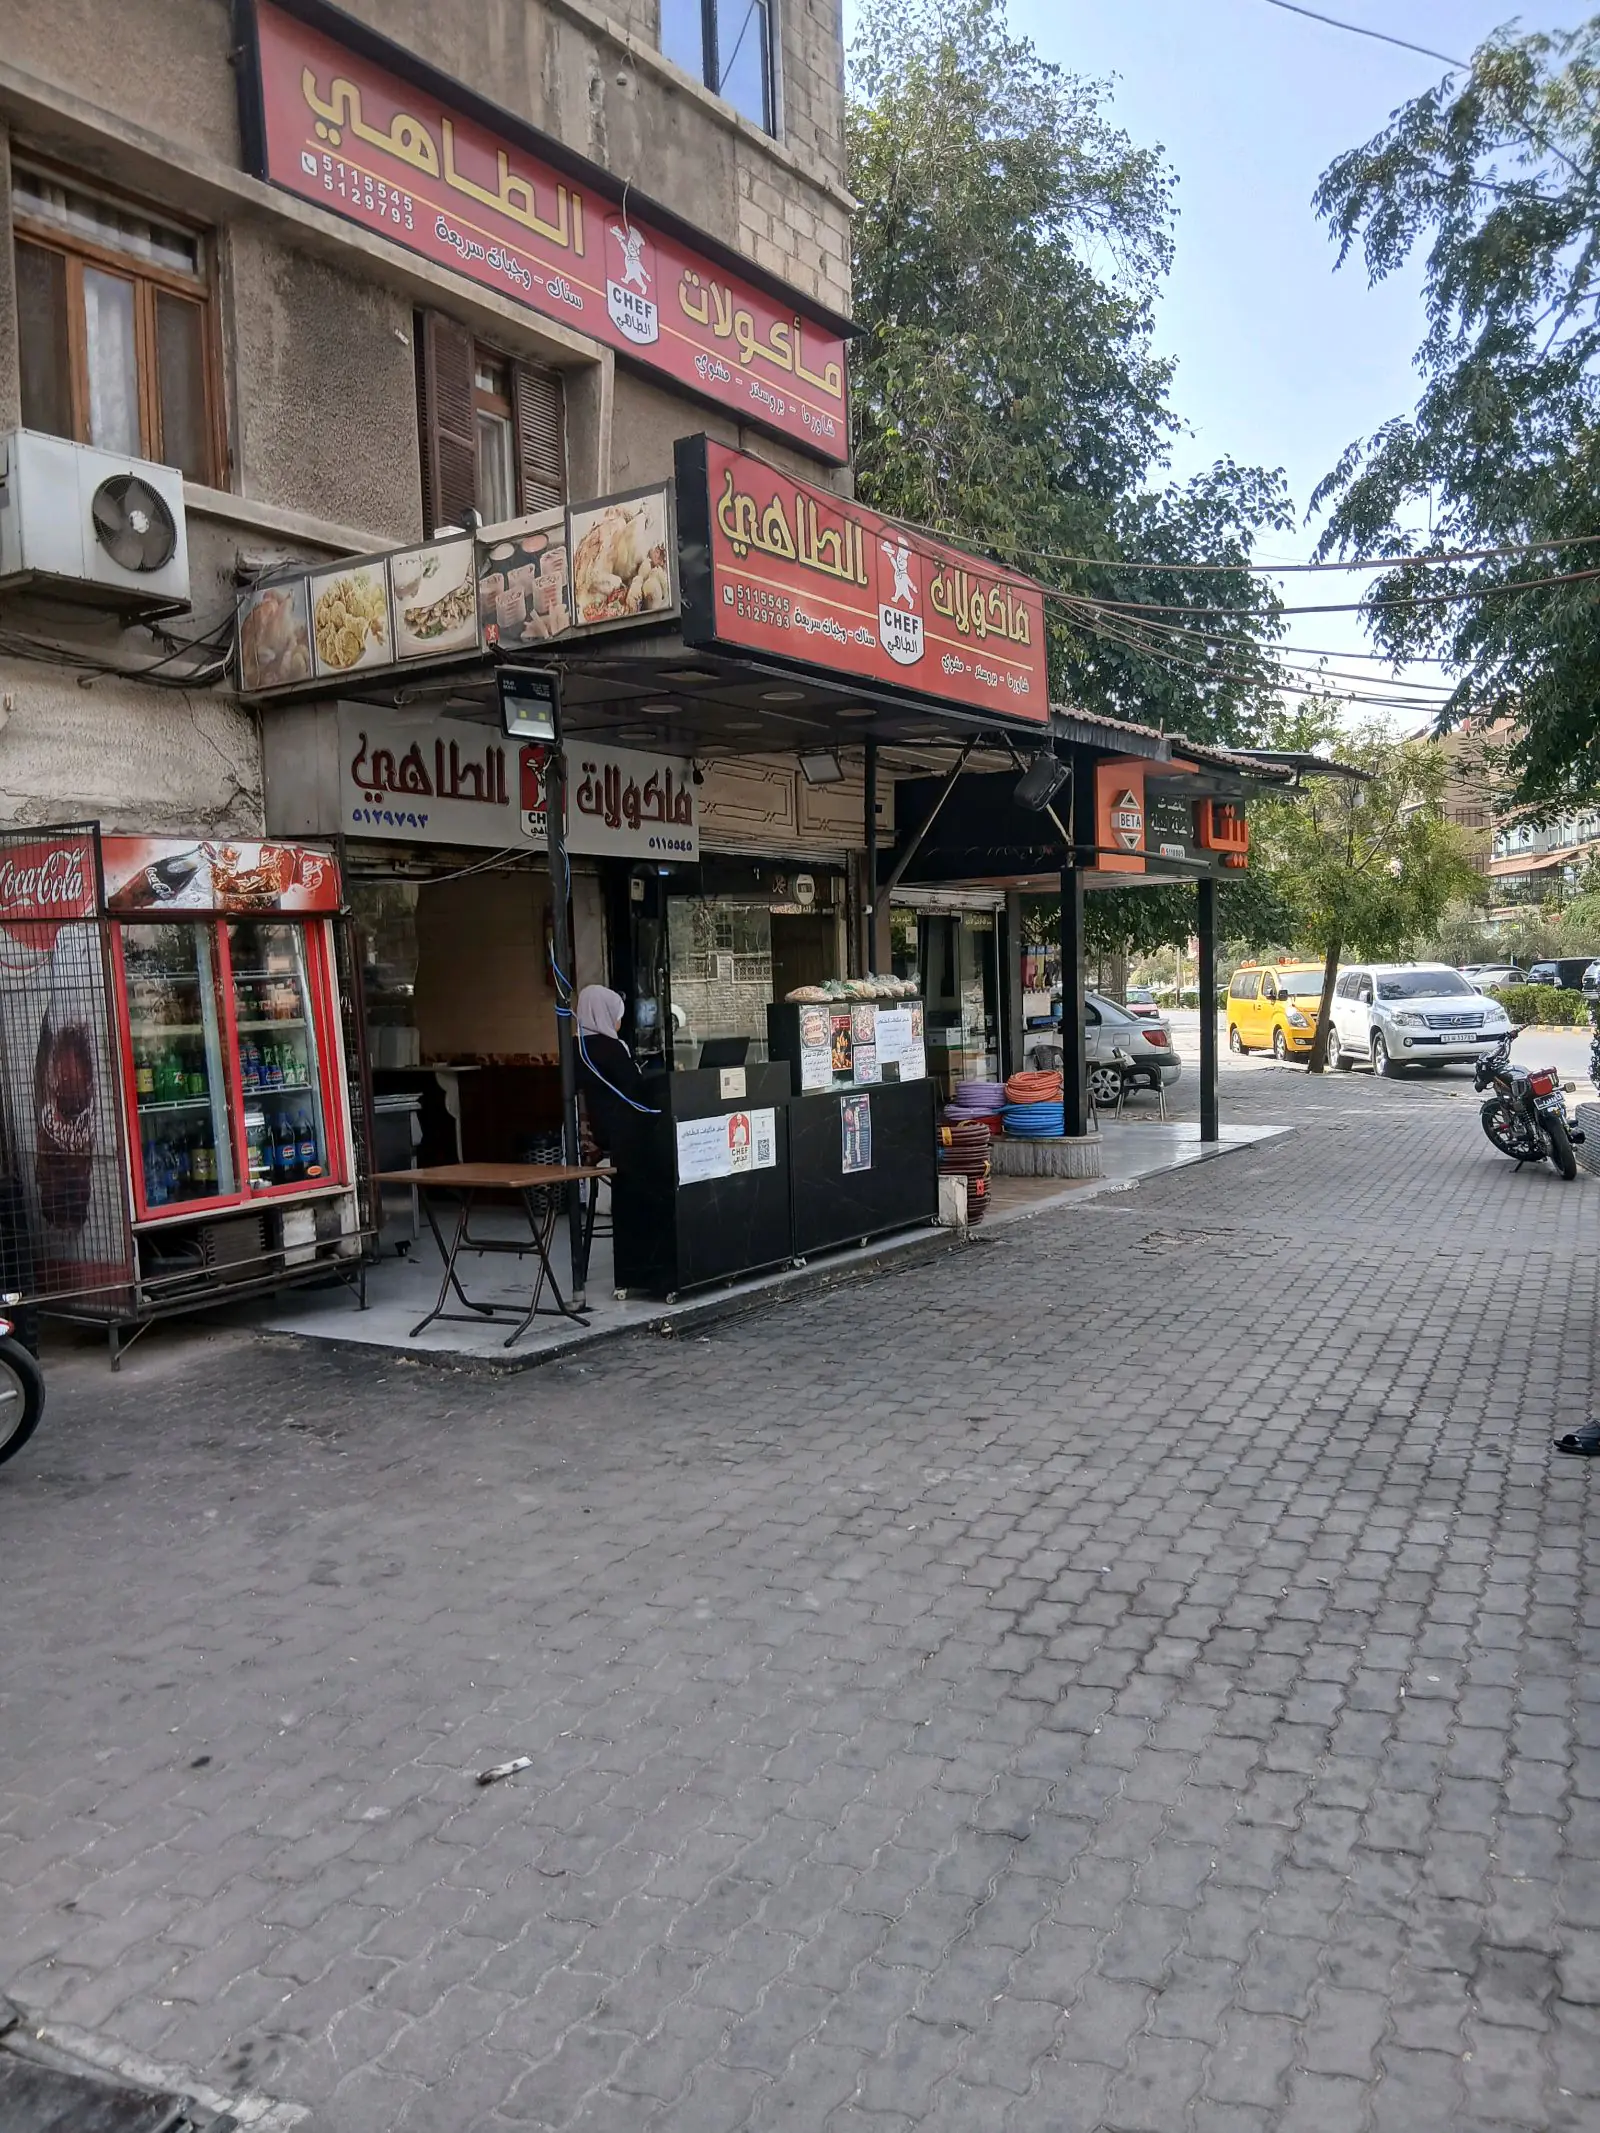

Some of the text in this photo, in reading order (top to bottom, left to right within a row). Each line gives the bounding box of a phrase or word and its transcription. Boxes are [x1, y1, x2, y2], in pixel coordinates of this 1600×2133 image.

[322, 155, 412, 211] 5115545
[323, 174, 414, 230] 5129793
[302, 65, 842, 399] مأكولات الطاهي
[434, 216, 485, 260] سريعة
[486, 248, 532, 289] وجبات
[546, 277, 583, 310] سناك
[612, 286, 652, 319] CHEF
[616, 313, 652, 337] الطاهي
[694, 354, 731, 382] مشوي
[801, 404, 835, 437] شاورما
[717, 470, 1031, 645] مأكولات الطاهي
[737, 584, 790, 612] 5115545
[737, 602, 791, 629] 5129793
[794, 606, 821, 634] سريعة
[883, 610, 920, 635] CHEF
[821, 620, 848, 647] وجبات
[854, 626, 877, 648] سناك
[886, 636, 919, 660] الطاهي
[941, 653, 964, 674] مشوي
[1007, 672, 1030, 694] شاورما
[351, 730, 510, 806] الطاهي
[1121, 814, 1141, 828] BETA
[731, 1147, 748, 1156] CHEF
